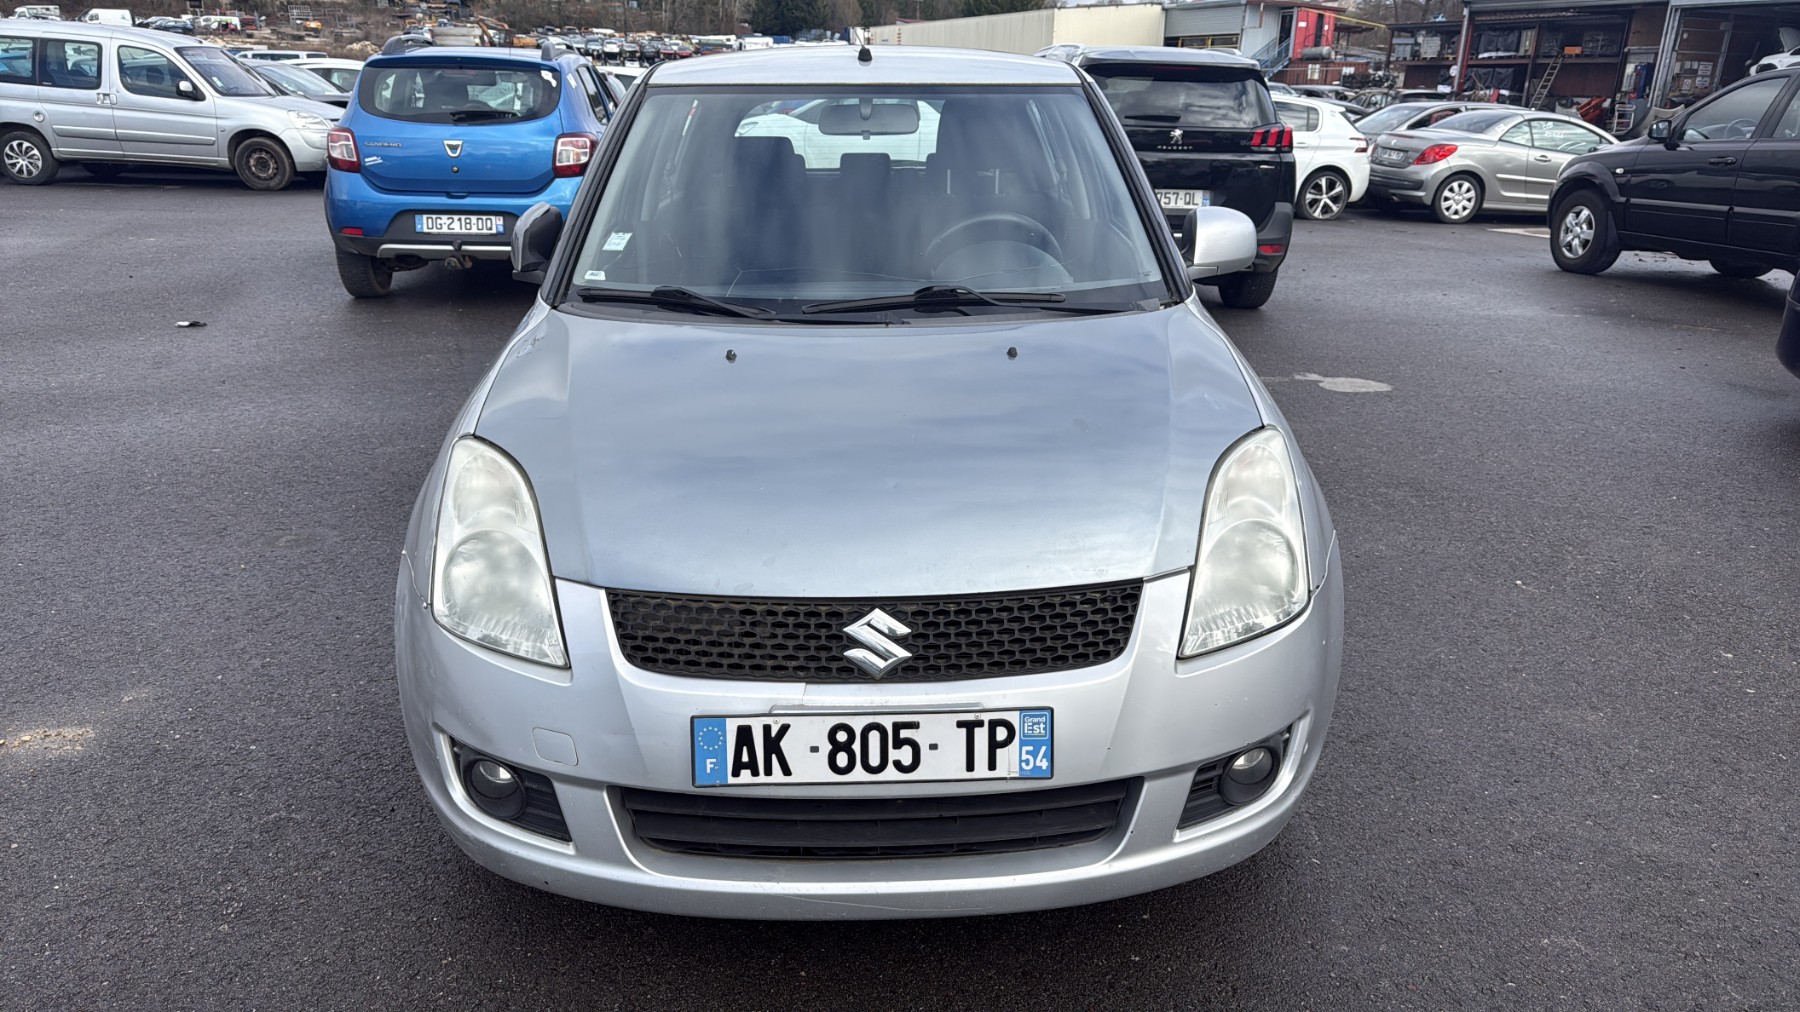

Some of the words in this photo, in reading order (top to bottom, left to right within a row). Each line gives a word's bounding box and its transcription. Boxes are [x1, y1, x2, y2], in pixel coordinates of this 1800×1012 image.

[426, 216, 493, 231] DG-218-DQ
[1024, 723, 1046, 734] Est
[1021, 745, 1049, 771] 54
[706, 758, 717, 774] F
